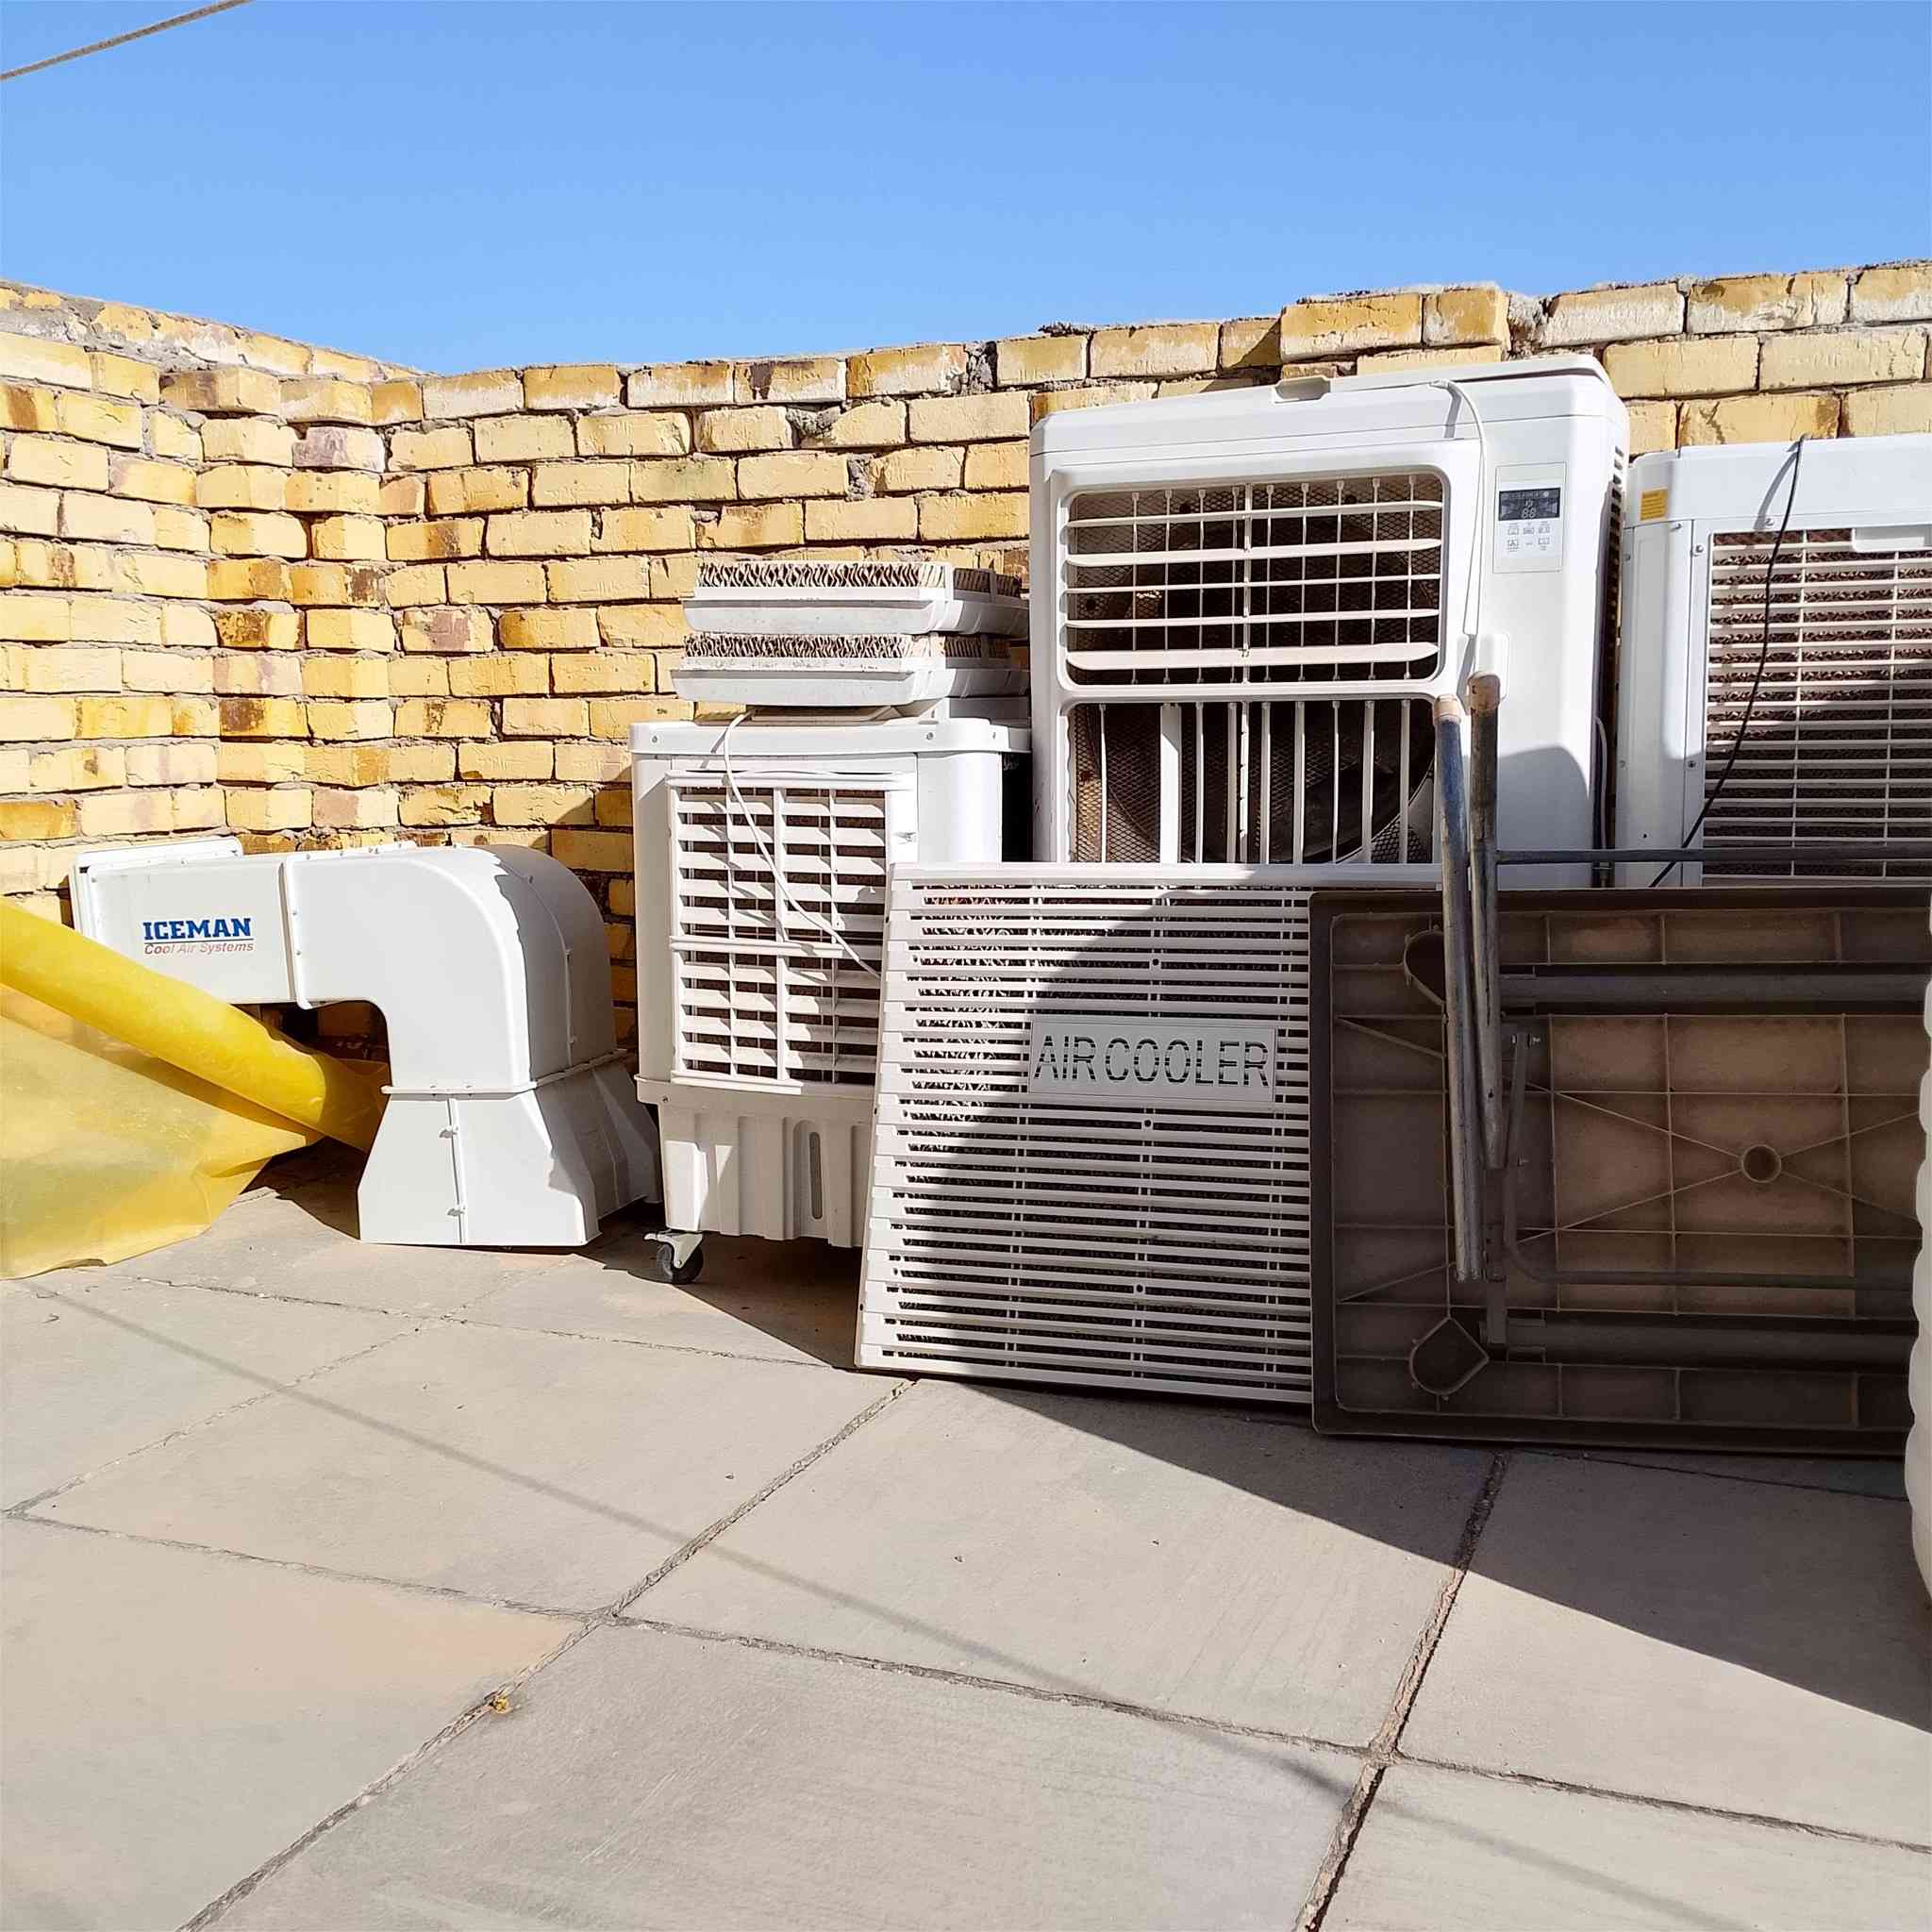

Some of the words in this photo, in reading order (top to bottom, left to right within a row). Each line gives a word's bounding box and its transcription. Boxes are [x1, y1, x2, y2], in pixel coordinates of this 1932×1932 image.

[142, 918, 251, 941] ICEMAN
[144, 944, 175, 955] Cool
[176, 944, 196, 954] Air
[200, 942, 255, 955] Systems
[1034, 1035, 1097, 1082] AIR
[1105, 1037, 1269, 1086] COOLER
